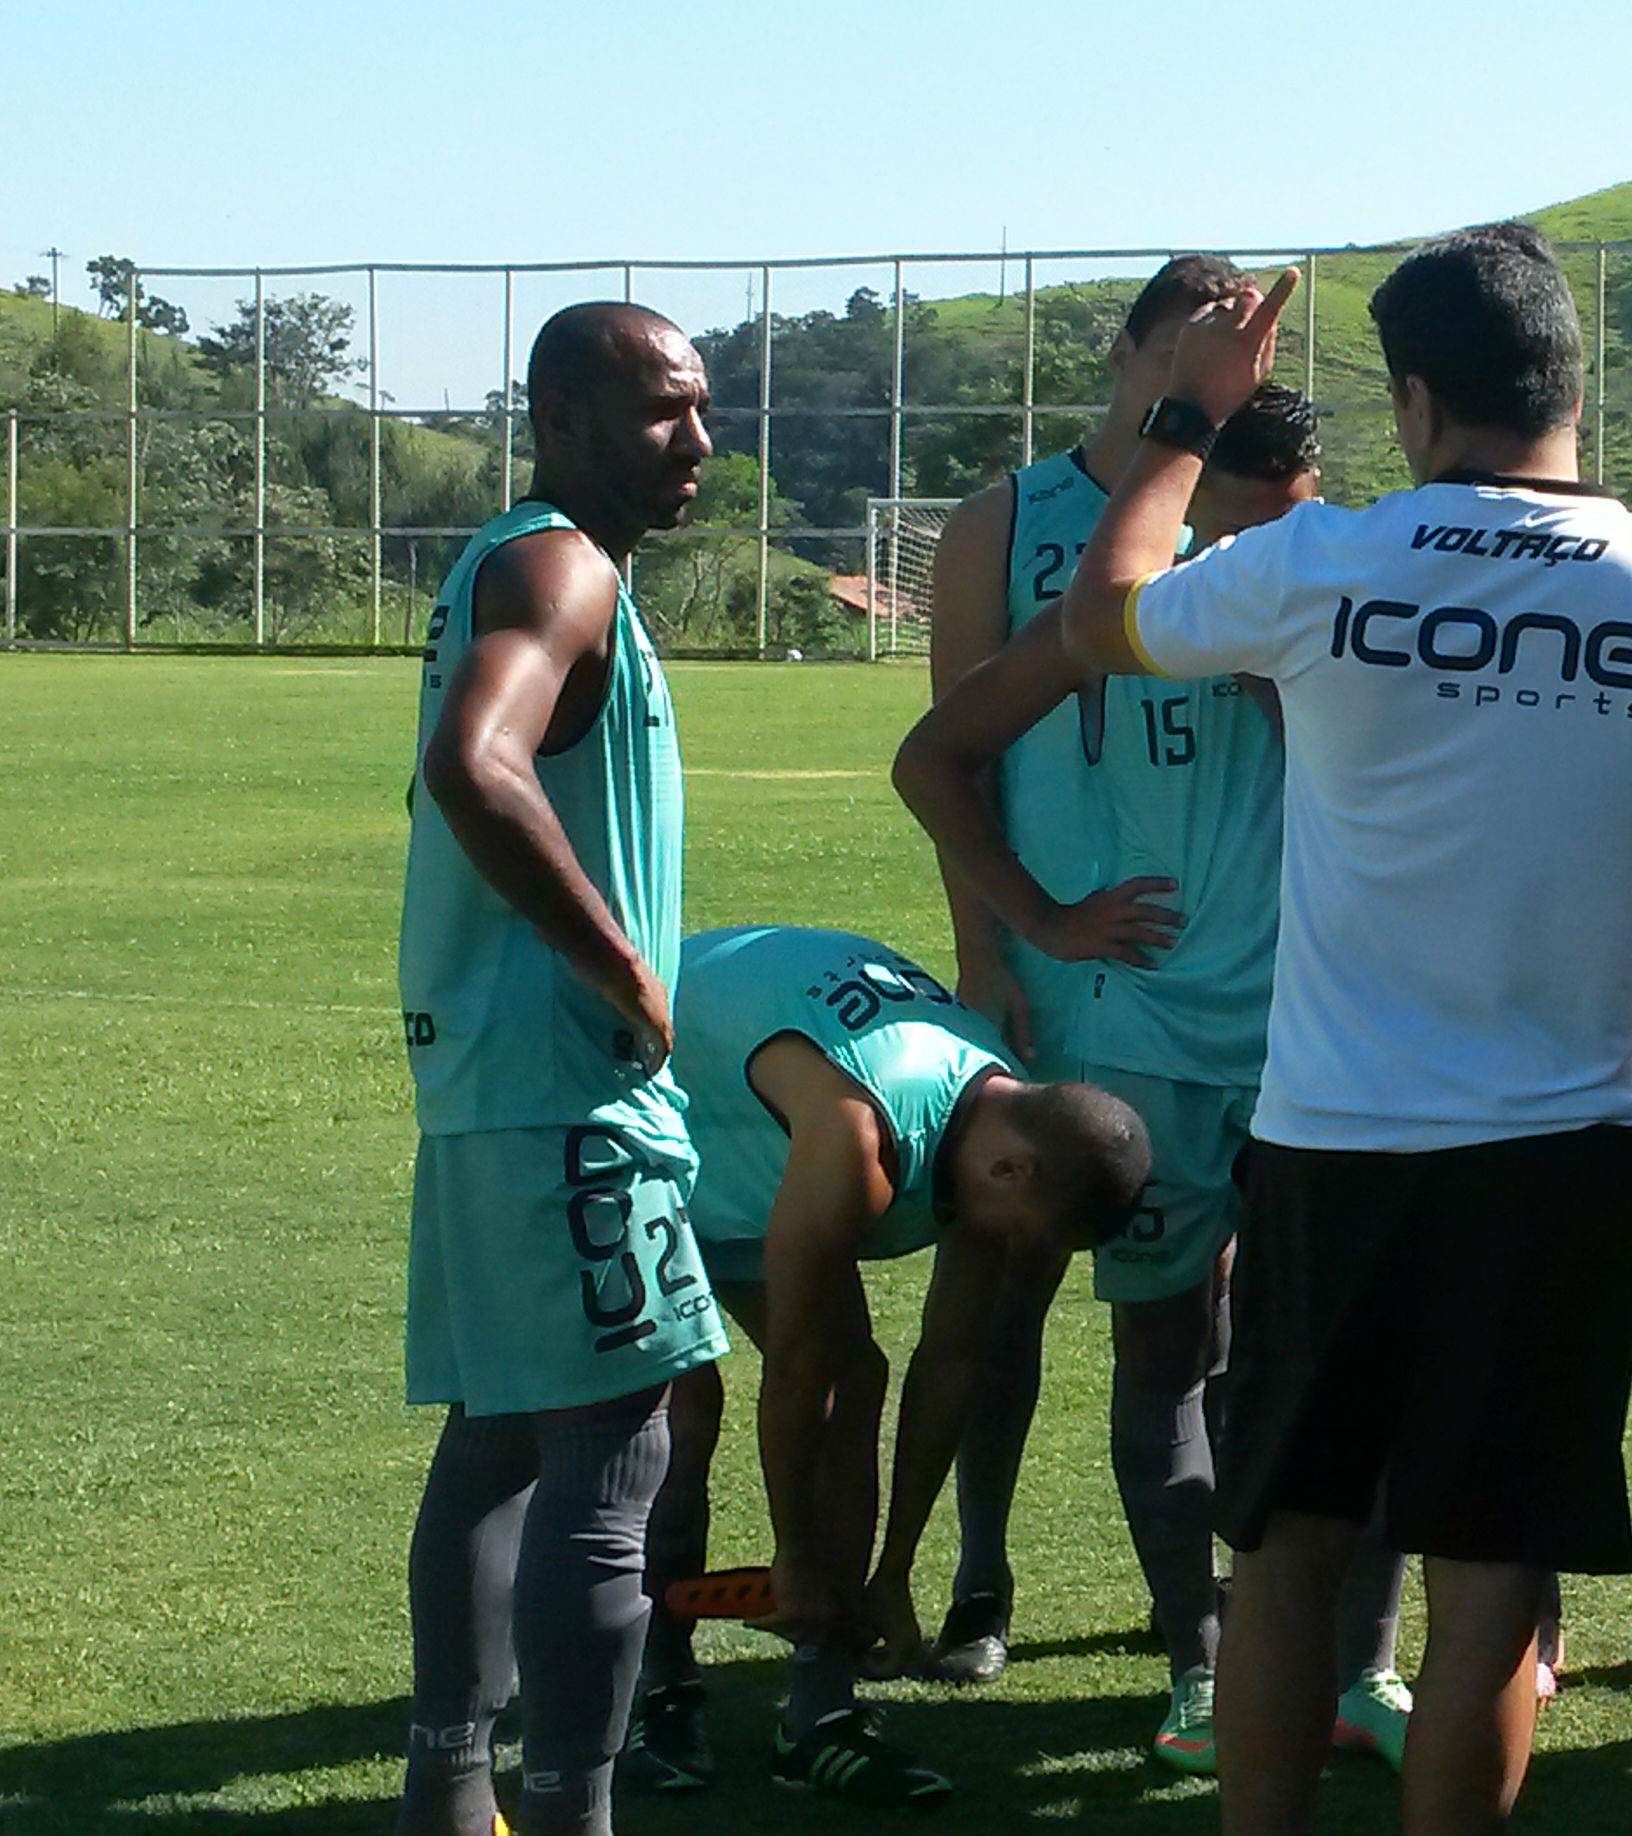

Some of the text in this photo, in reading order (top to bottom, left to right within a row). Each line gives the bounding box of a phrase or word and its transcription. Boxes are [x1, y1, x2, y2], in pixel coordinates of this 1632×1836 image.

[1033, 541, 1087, 602] 2
[1411, 523, 1609, 567] VOLTAÇO
[1140, 695, 1196, 767] 15
[644, 1207, 698, 1298] 2
